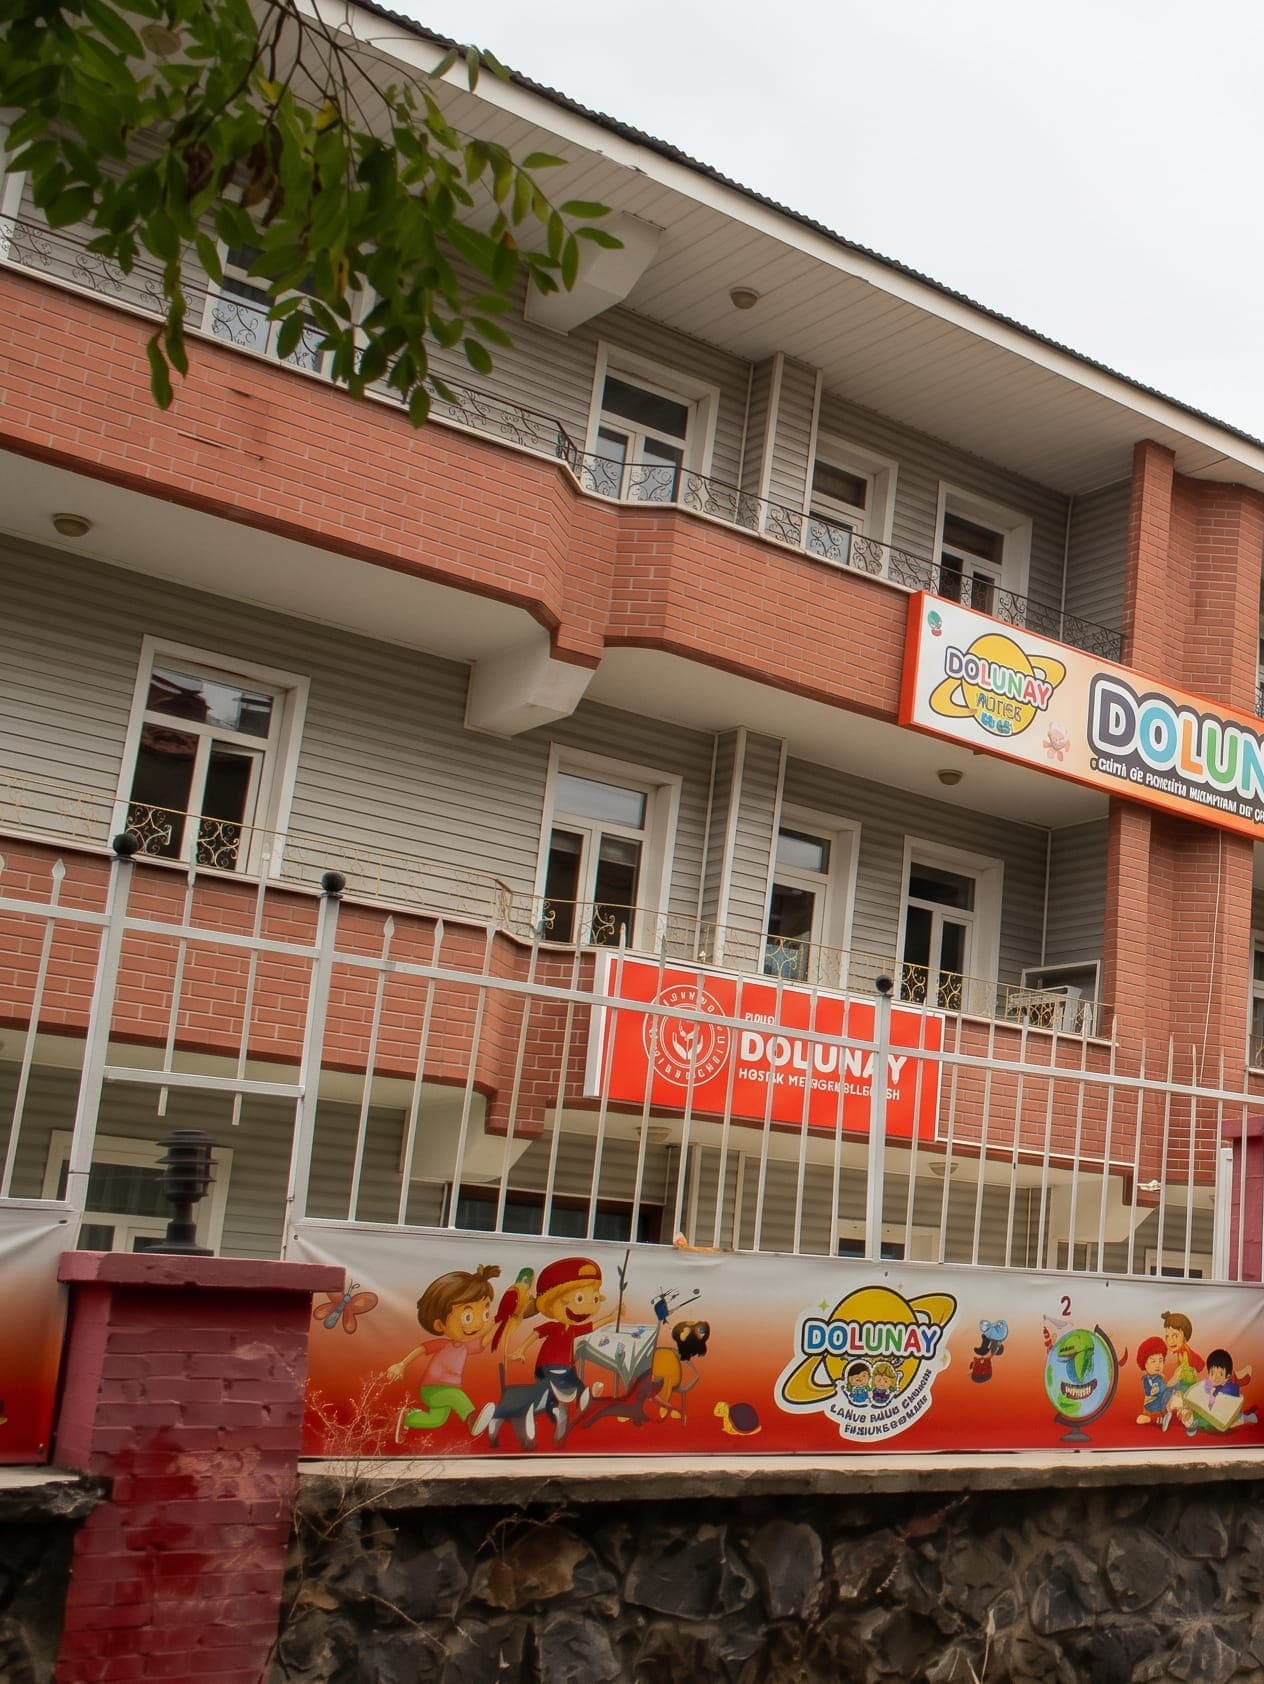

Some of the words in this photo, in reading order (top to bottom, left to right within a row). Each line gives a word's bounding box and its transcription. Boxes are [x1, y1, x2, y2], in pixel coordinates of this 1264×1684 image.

[947, 650, 1051, 708] DOLUNAY
[1060, 1295, 1072, 1317] 2
[806, 1323, 938, 1354] DOLUNAY
